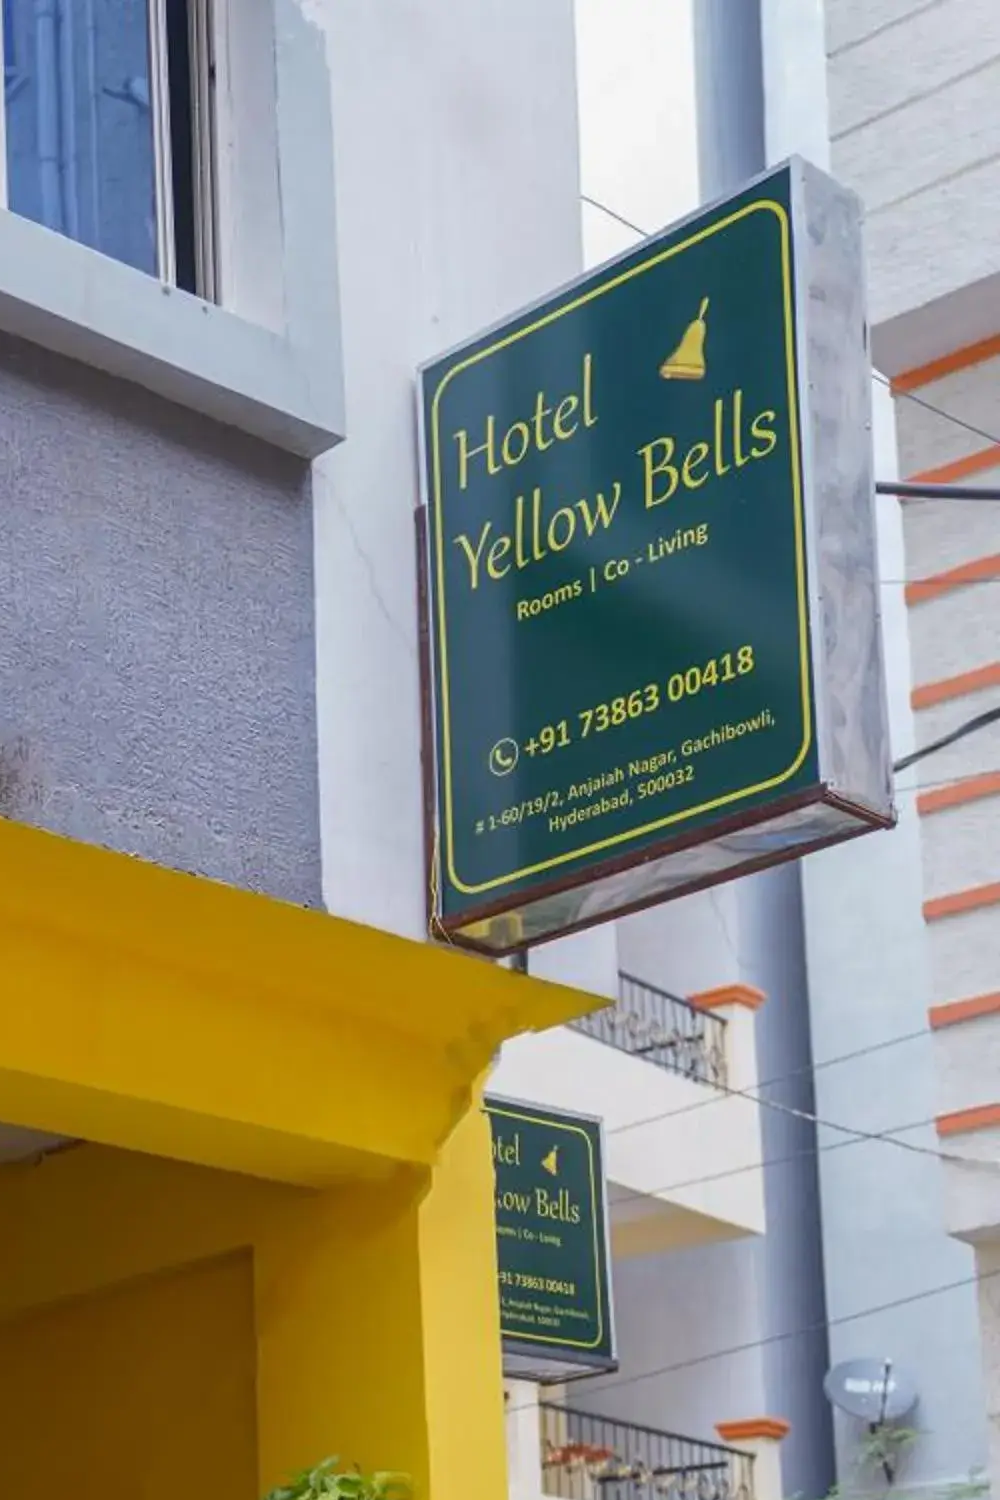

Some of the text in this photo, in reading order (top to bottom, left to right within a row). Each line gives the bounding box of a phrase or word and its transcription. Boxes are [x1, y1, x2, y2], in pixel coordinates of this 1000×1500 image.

[453, 353, 598, 489] Hotel
[453, 389, 777, 590] Yellow Bells
[516, 579, 583, 621] Rooms
[603, 559, 630, 581] Co
[648, 522, 709, 563] Living
[525, 645, 755, 757] +91 73863 00418
[488, 790, 565, 831] 1-60/19/2,
[567, 767, 625, 800] Anjaiah
[628, 750, 677, 777] Nagar,
[681, 708, 776, 757] Gachibowli,
[549, 786, 633, 833] Hyderabad,
[493, 1133, 520, 1165] tel
[534, 1187, 580, 1225] Bells
